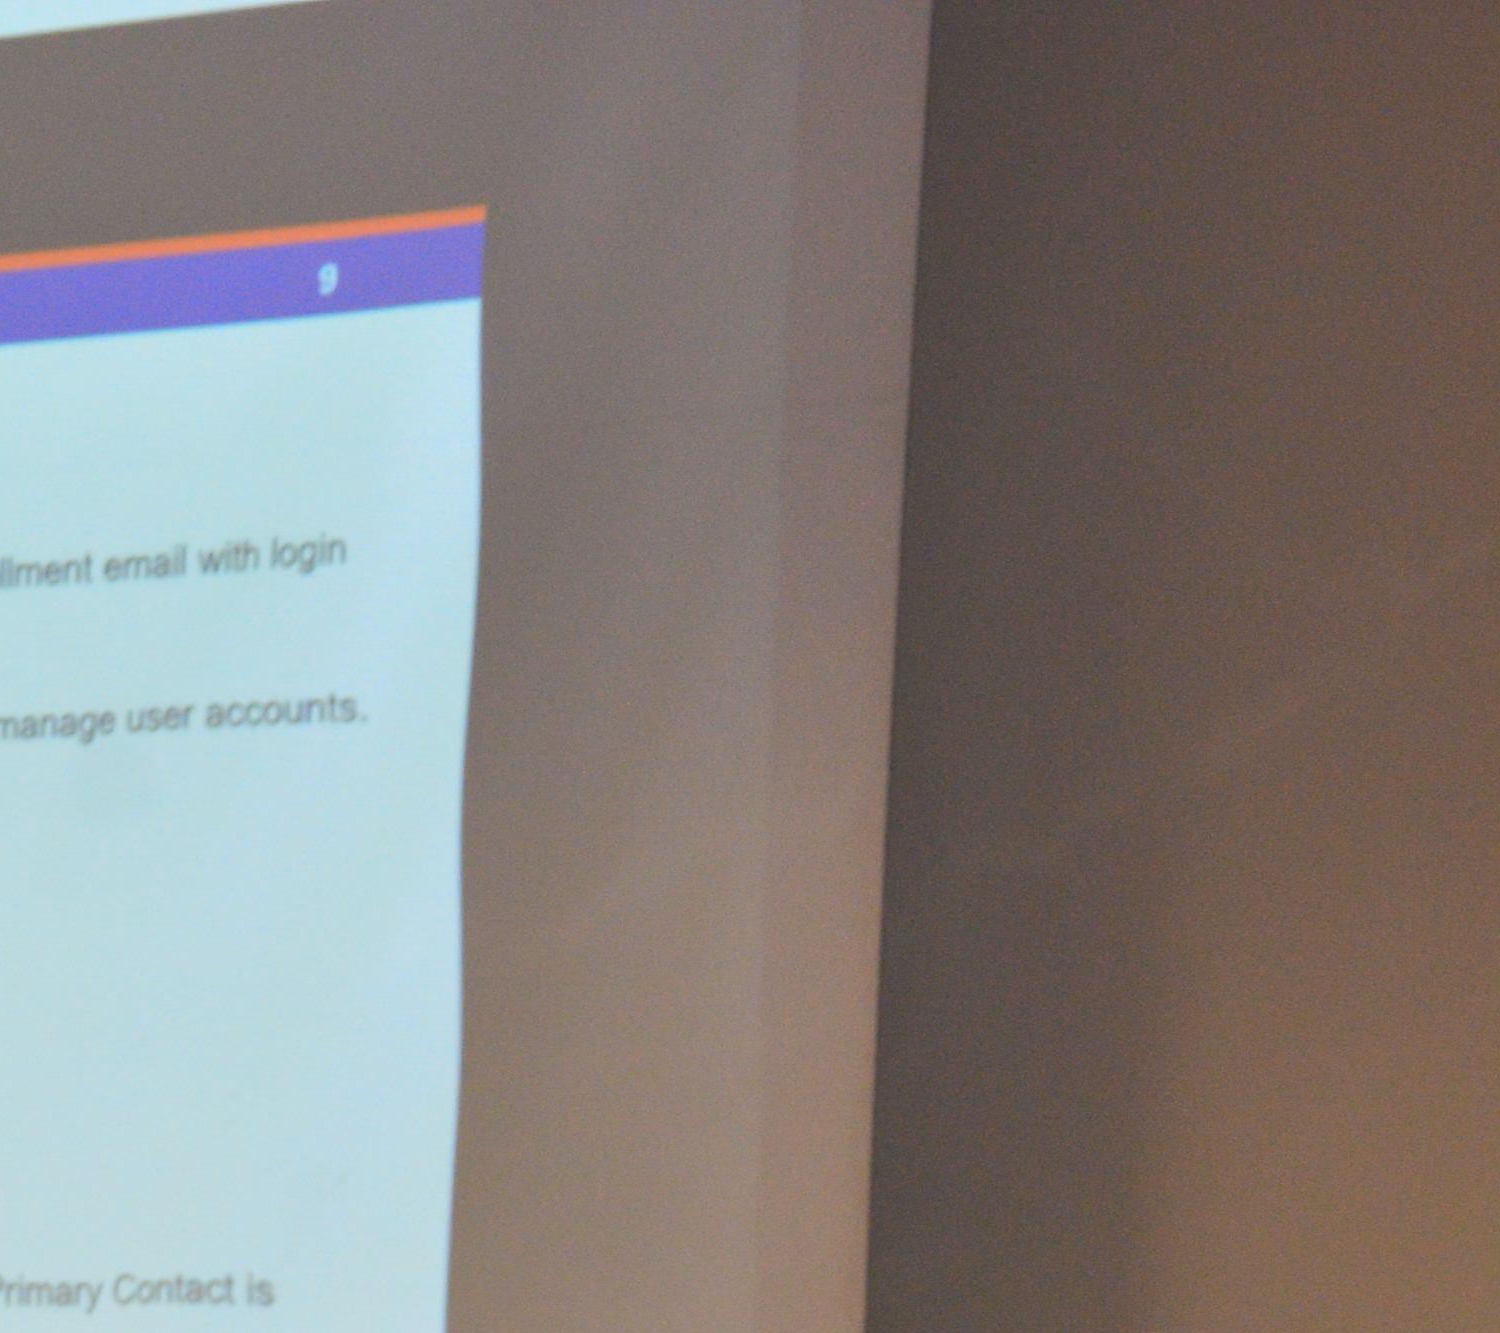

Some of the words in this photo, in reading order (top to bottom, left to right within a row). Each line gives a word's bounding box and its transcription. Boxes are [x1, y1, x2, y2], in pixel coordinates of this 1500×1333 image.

[318, 261, 340, 297] 9
[103, 543, 188, 583] email
[198, 539, 260, 575] with
[271, 533, 348, 575] login
[126, 703, 194, 735] user
[113, 1272, 235, 1307] Contact
[247, 1273, 276, 1307] is
